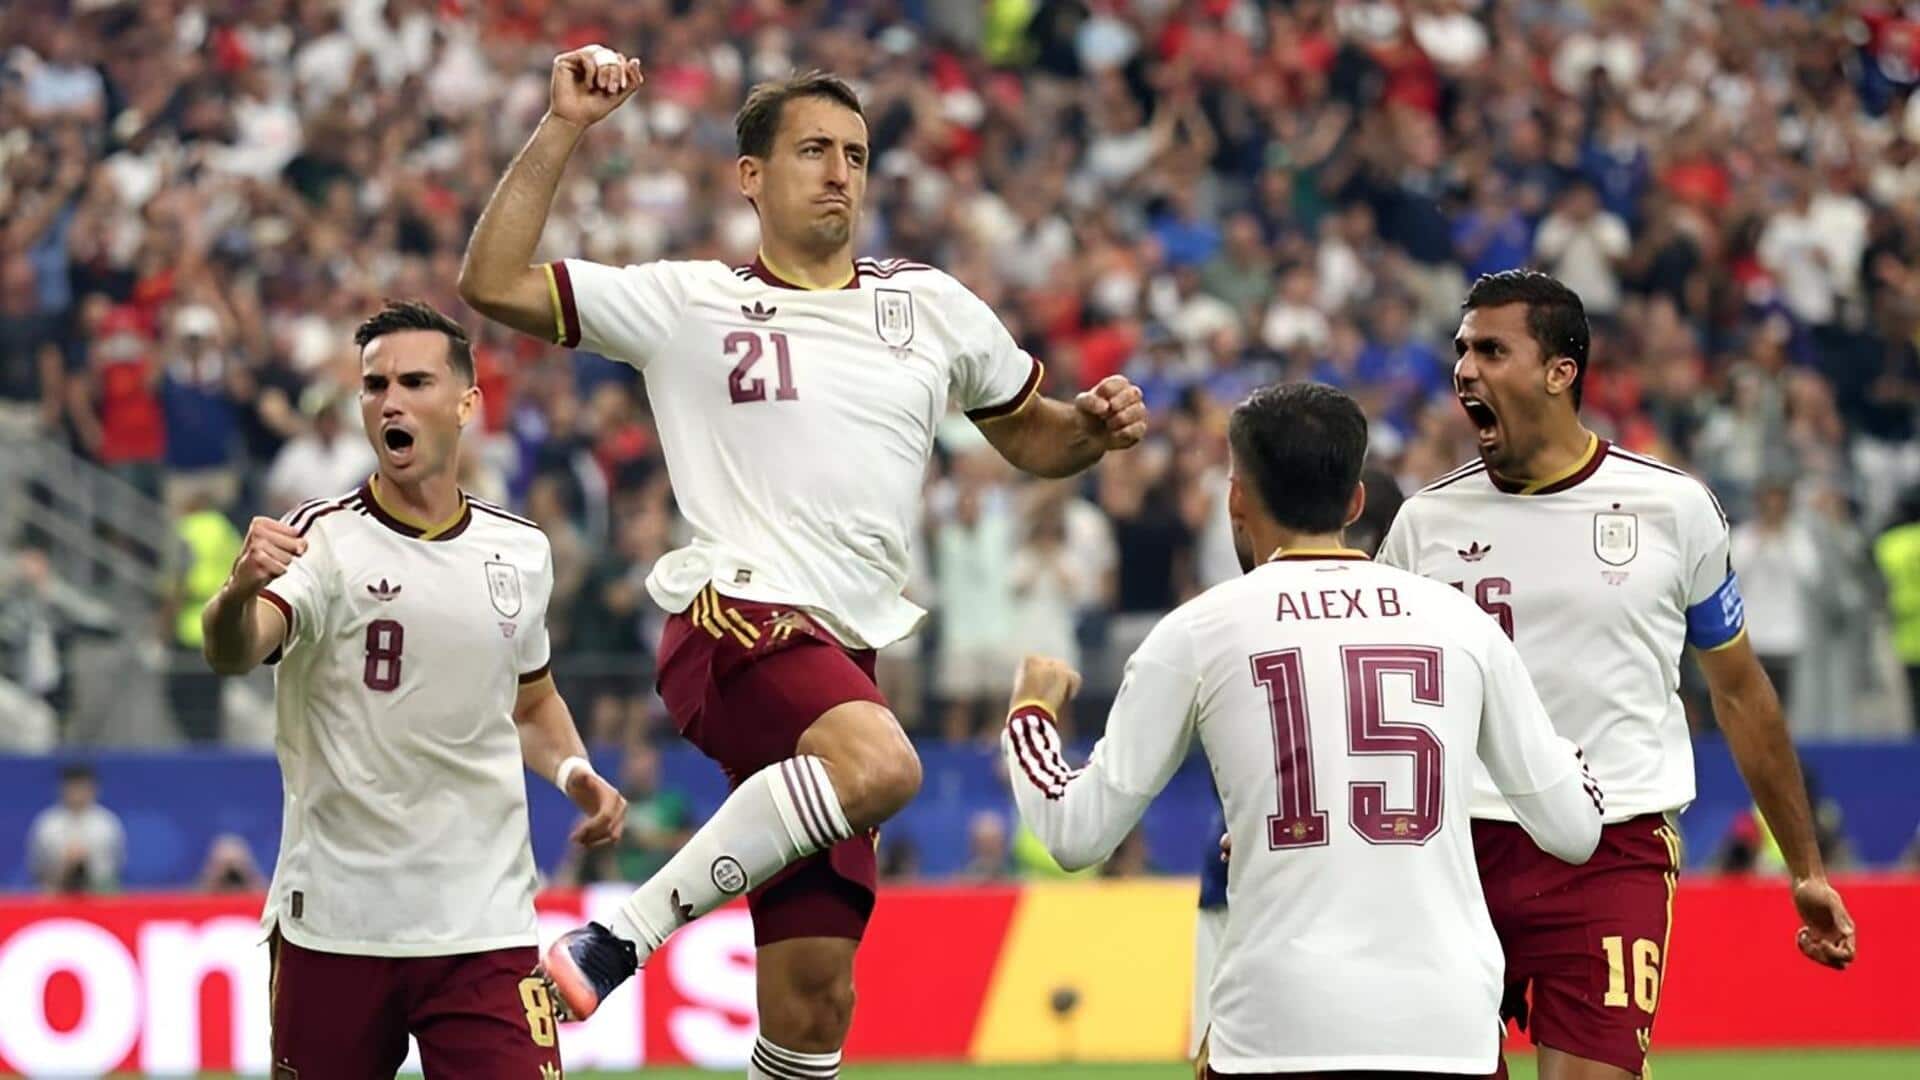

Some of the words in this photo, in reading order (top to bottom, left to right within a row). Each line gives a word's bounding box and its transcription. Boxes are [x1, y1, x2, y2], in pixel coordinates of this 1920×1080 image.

[723, 331, 800, 404] 21
[1276, 588, 1369, 621] ALEX
[1377, 587, 1411, 616] B.
[363, 618, 404, 692] 8
[1249, 644, 1444, 851] 15
[1602, 936, 1660, 1014] 16
[518, 977, 555, 1047] 8
